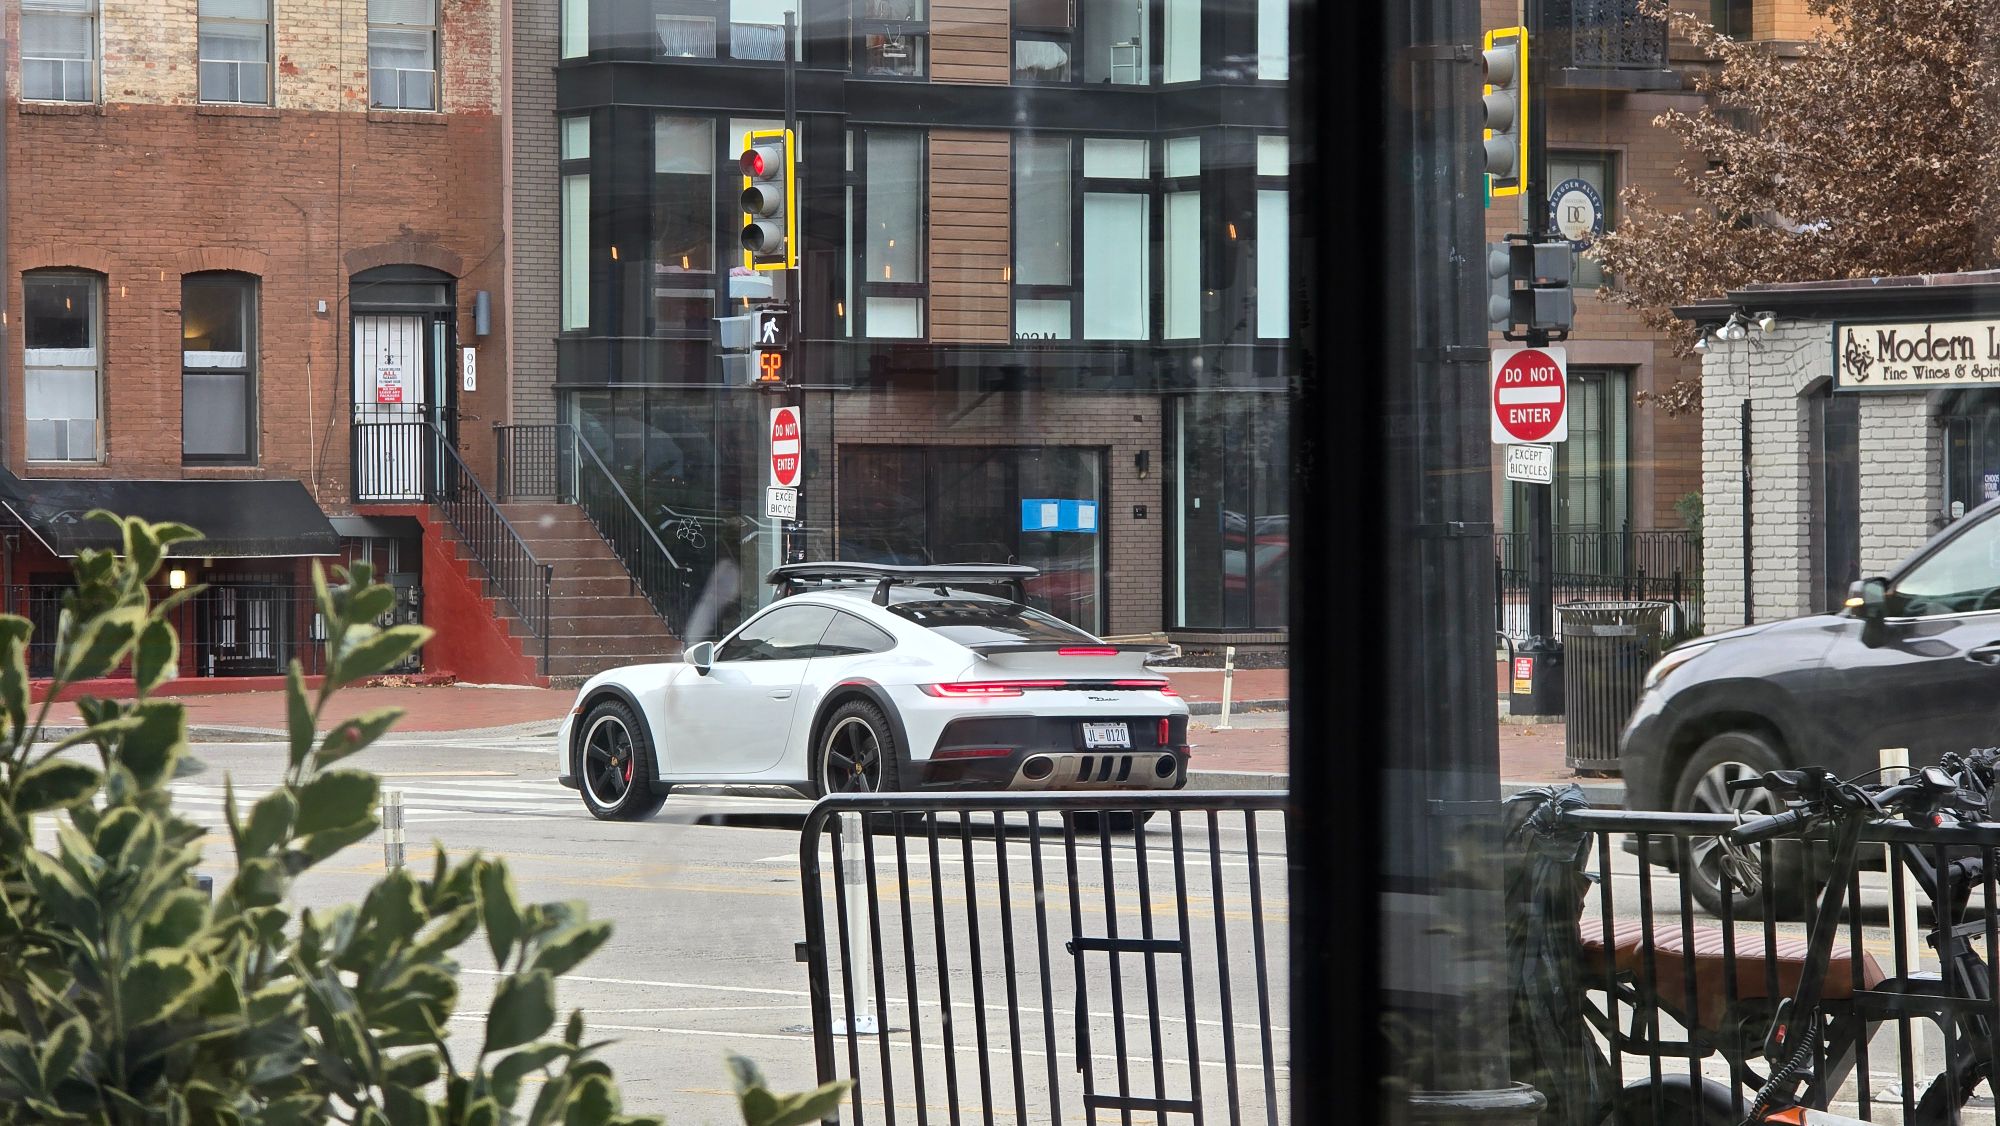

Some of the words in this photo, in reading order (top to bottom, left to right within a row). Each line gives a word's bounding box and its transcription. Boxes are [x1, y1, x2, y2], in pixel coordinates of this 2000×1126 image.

[1551, 181, 1579, 207] BLAGDEN
[1582, 185, 1600, 207] ALLEY
[1567, 206, 1585, 223] DC
[1876, 324, 1975, 362] Modern
[1505, 368, 1522, 383] DO
[1530, 366, 1555, 382] NOT
[1883, 366, 1907, 380] Fine
[1912, 365, 1950, 379] Wines
[1954, 364, 1967, 378] &
[1510, 408, 1550, 423] ENTER
[776, 424, 784, 436] DO
[785, 423, 796, 436] NOT
[1515, 449, 1542, 461] EXCEPT
[778, 458, 794, 470] ENTER
[1510, 463, 1547, 477] BICYCLES
[1089, 729, 1098, 742] JL
